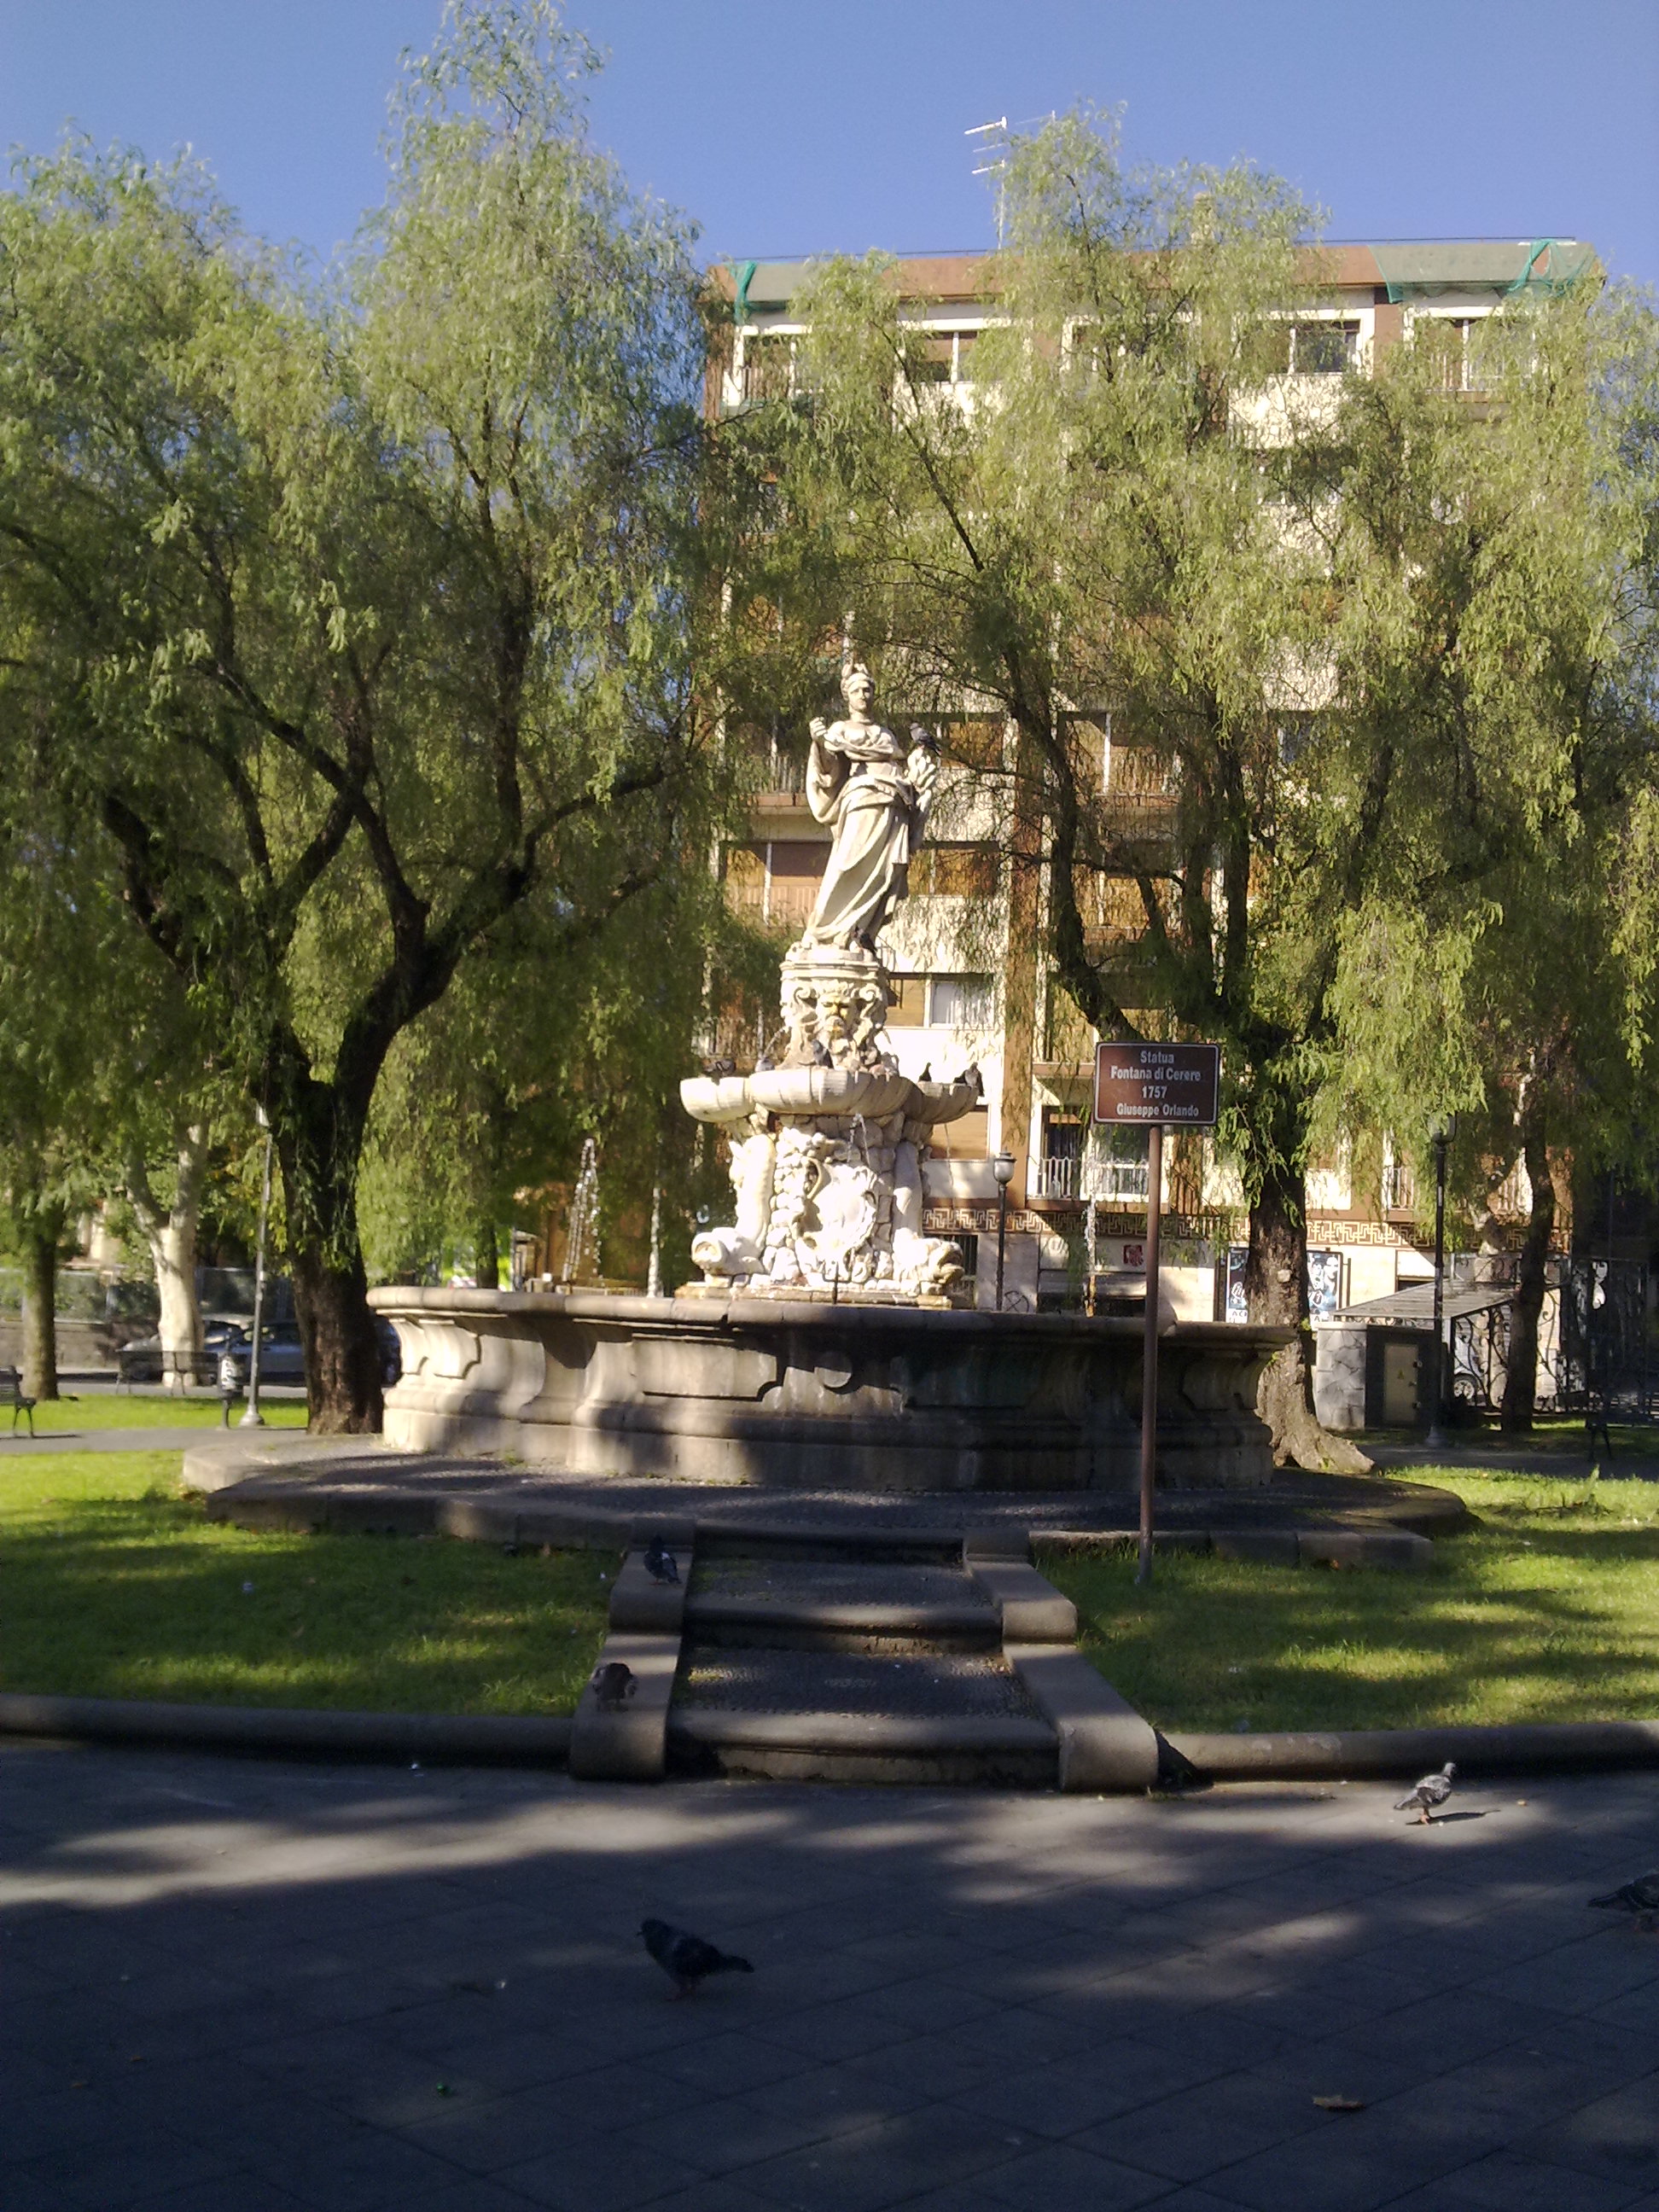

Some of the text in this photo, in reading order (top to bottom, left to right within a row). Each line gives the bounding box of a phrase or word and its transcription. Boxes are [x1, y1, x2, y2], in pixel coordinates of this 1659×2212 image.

[1140, 1051, 1174, 1064] Statua
[1110, 1065, 1201, 1081] Fontana di Cerere
[1142, 1085, 1167, 1099] 1757
[1116, 1103, 1199, 1118] Giuseppe Orlando
